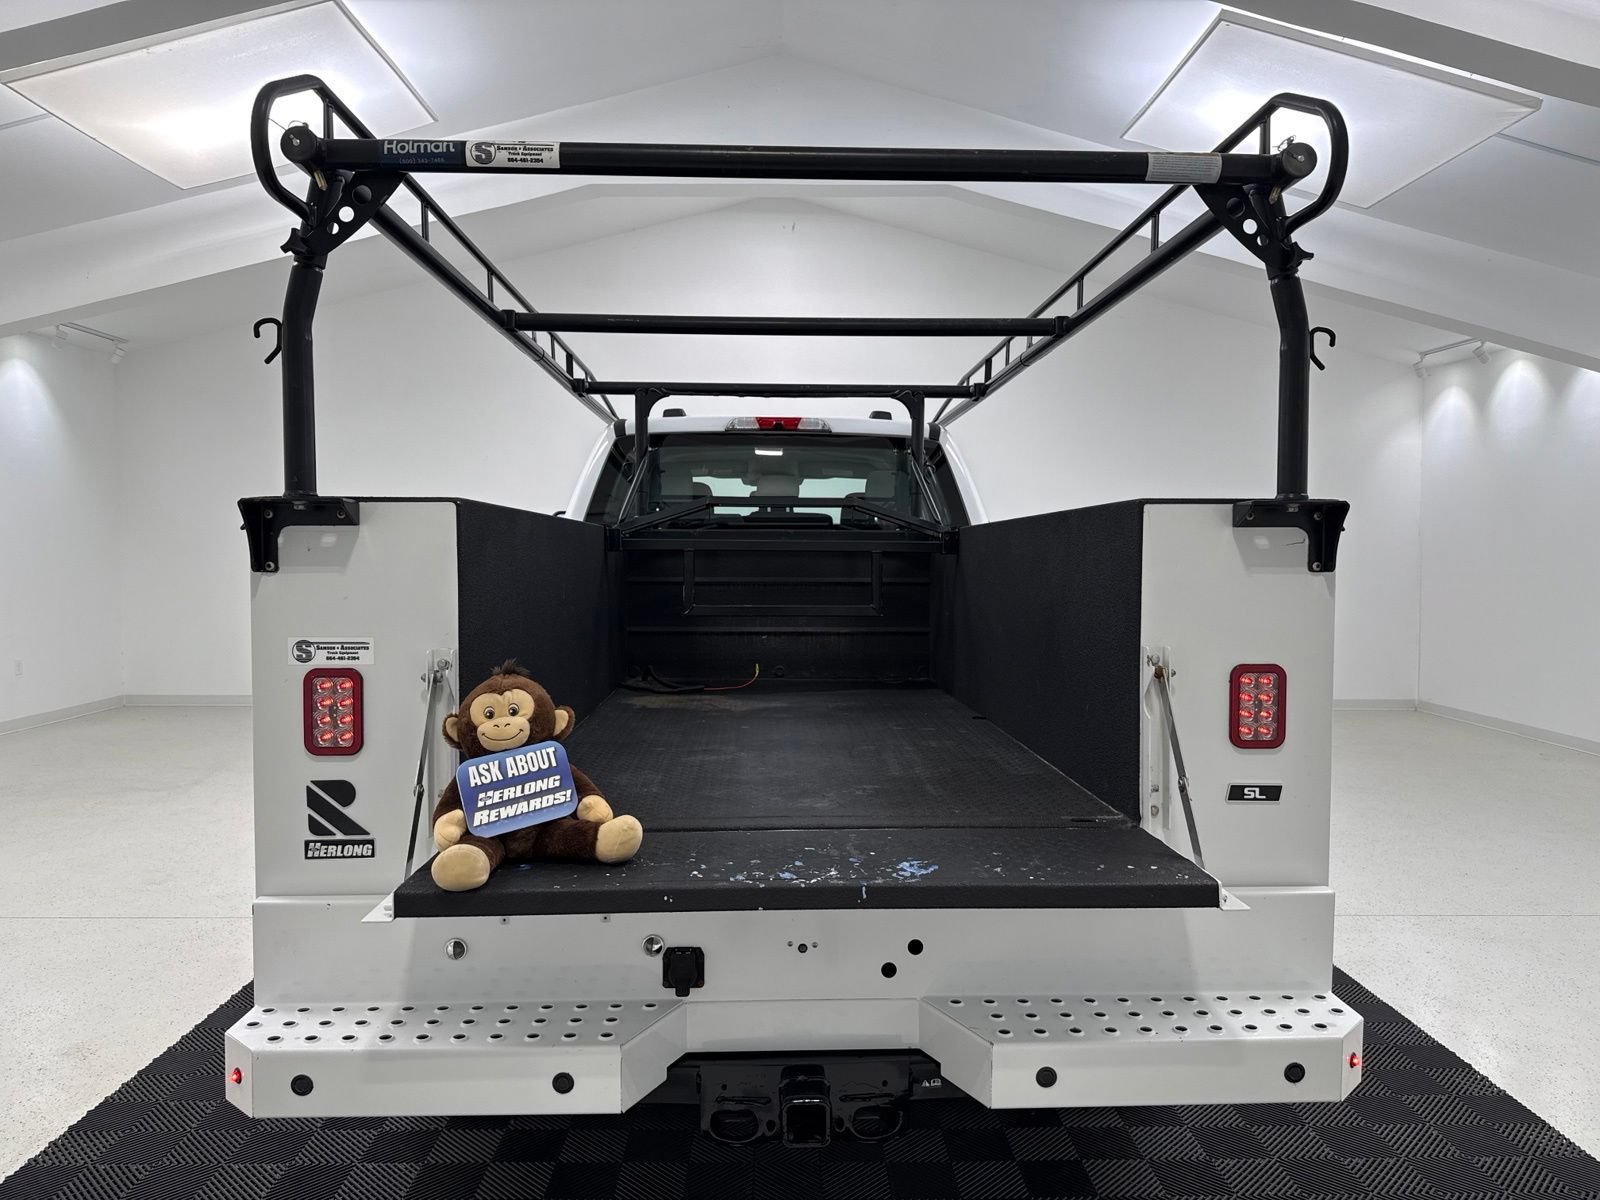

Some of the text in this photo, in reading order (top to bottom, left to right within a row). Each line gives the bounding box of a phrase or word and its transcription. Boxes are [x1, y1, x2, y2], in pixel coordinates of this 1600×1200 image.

[383, 140, 455, 155] Holman
[468, 746, 557, 788] ASK ABOUT
[477, 775, 561, 808] HERLONG
[1243, 787, 1267, 799] SL
[473, 789, 572, 827] REWARDS!
[306, 842, 373, 857] HERLONG
